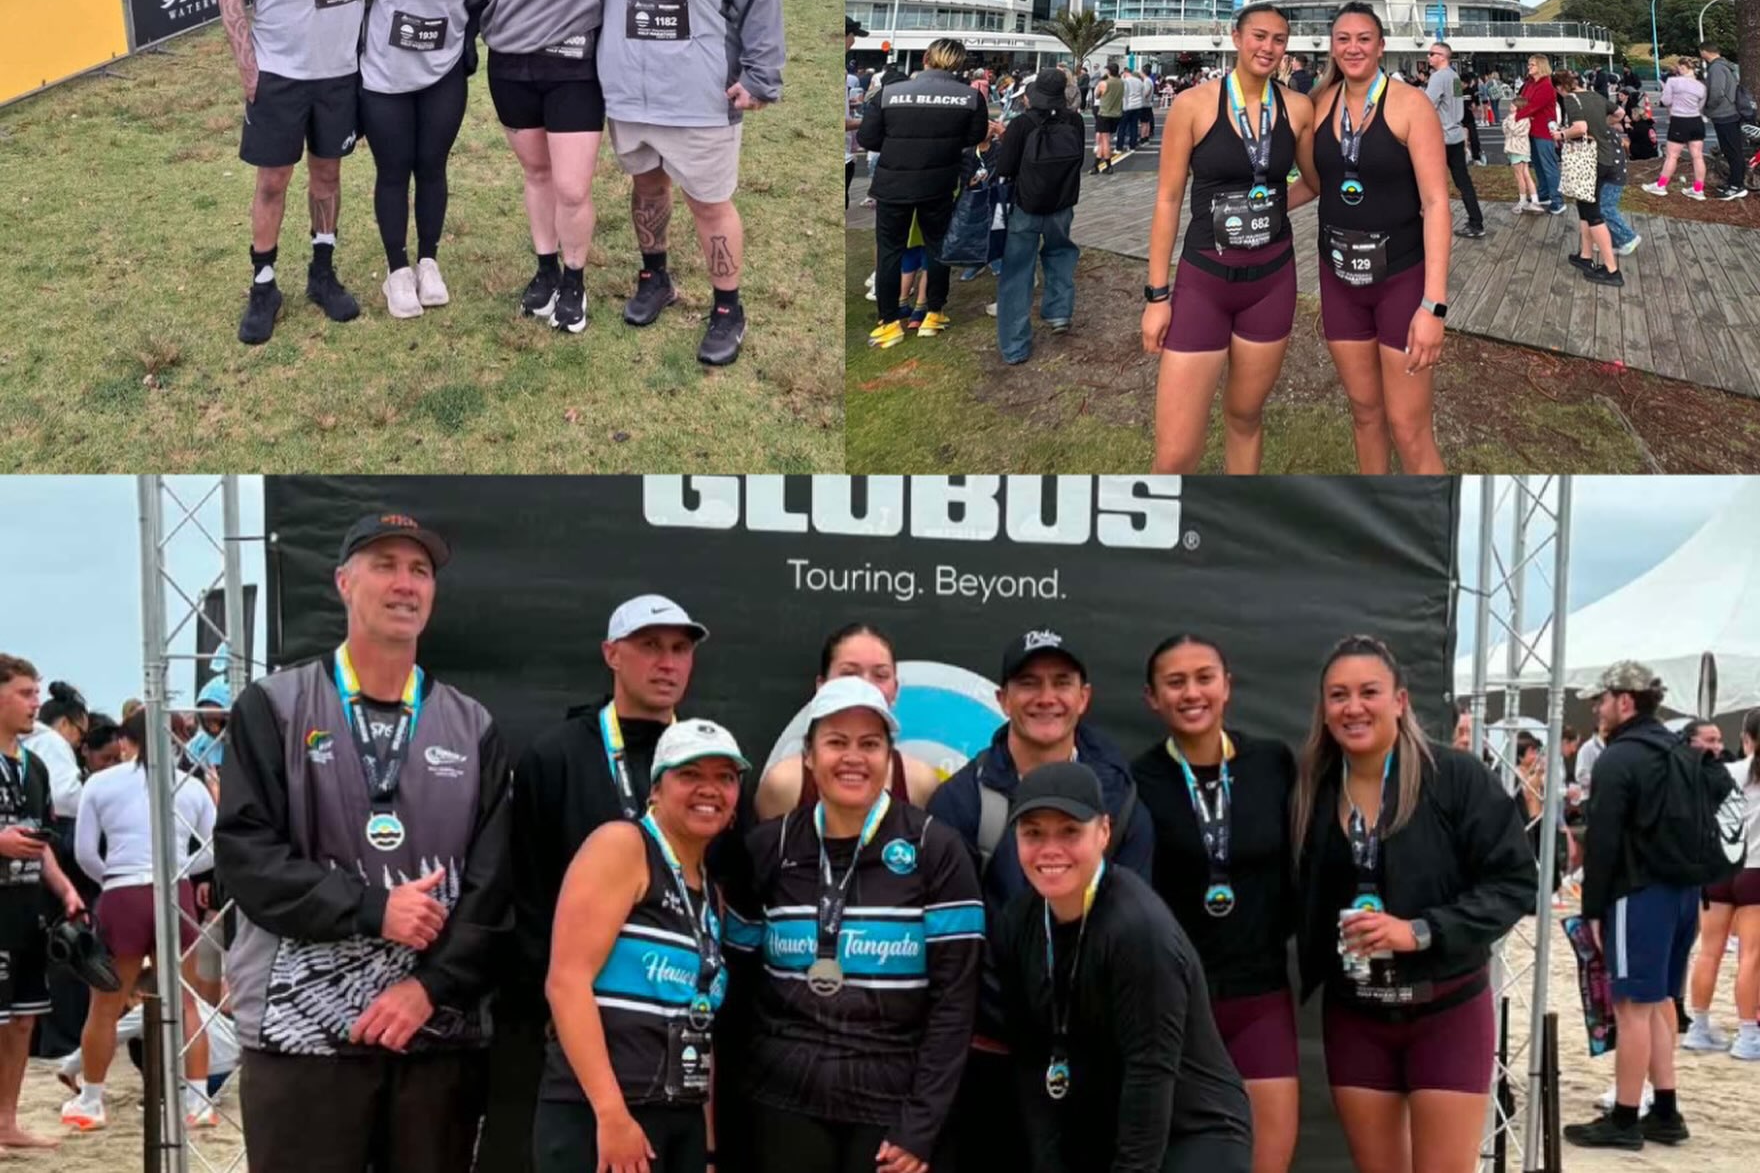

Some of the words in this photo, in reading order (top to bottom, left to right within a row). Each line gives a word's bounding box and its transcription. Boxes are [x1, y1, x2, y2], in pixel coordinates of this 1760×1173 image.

[654, 16, 678, 26] 1182
[889, 95, 913, 105] ALL
[916, 94, 968, 105] BLACKS
[1251, 216, 1270, 230] 682
[1351, 258, 1371, 270] 129
[787, 559, 924, 602] Touring.
[935, 565, 1067, 604] Beyond.
[839, 929, 920, 965] Tangata
